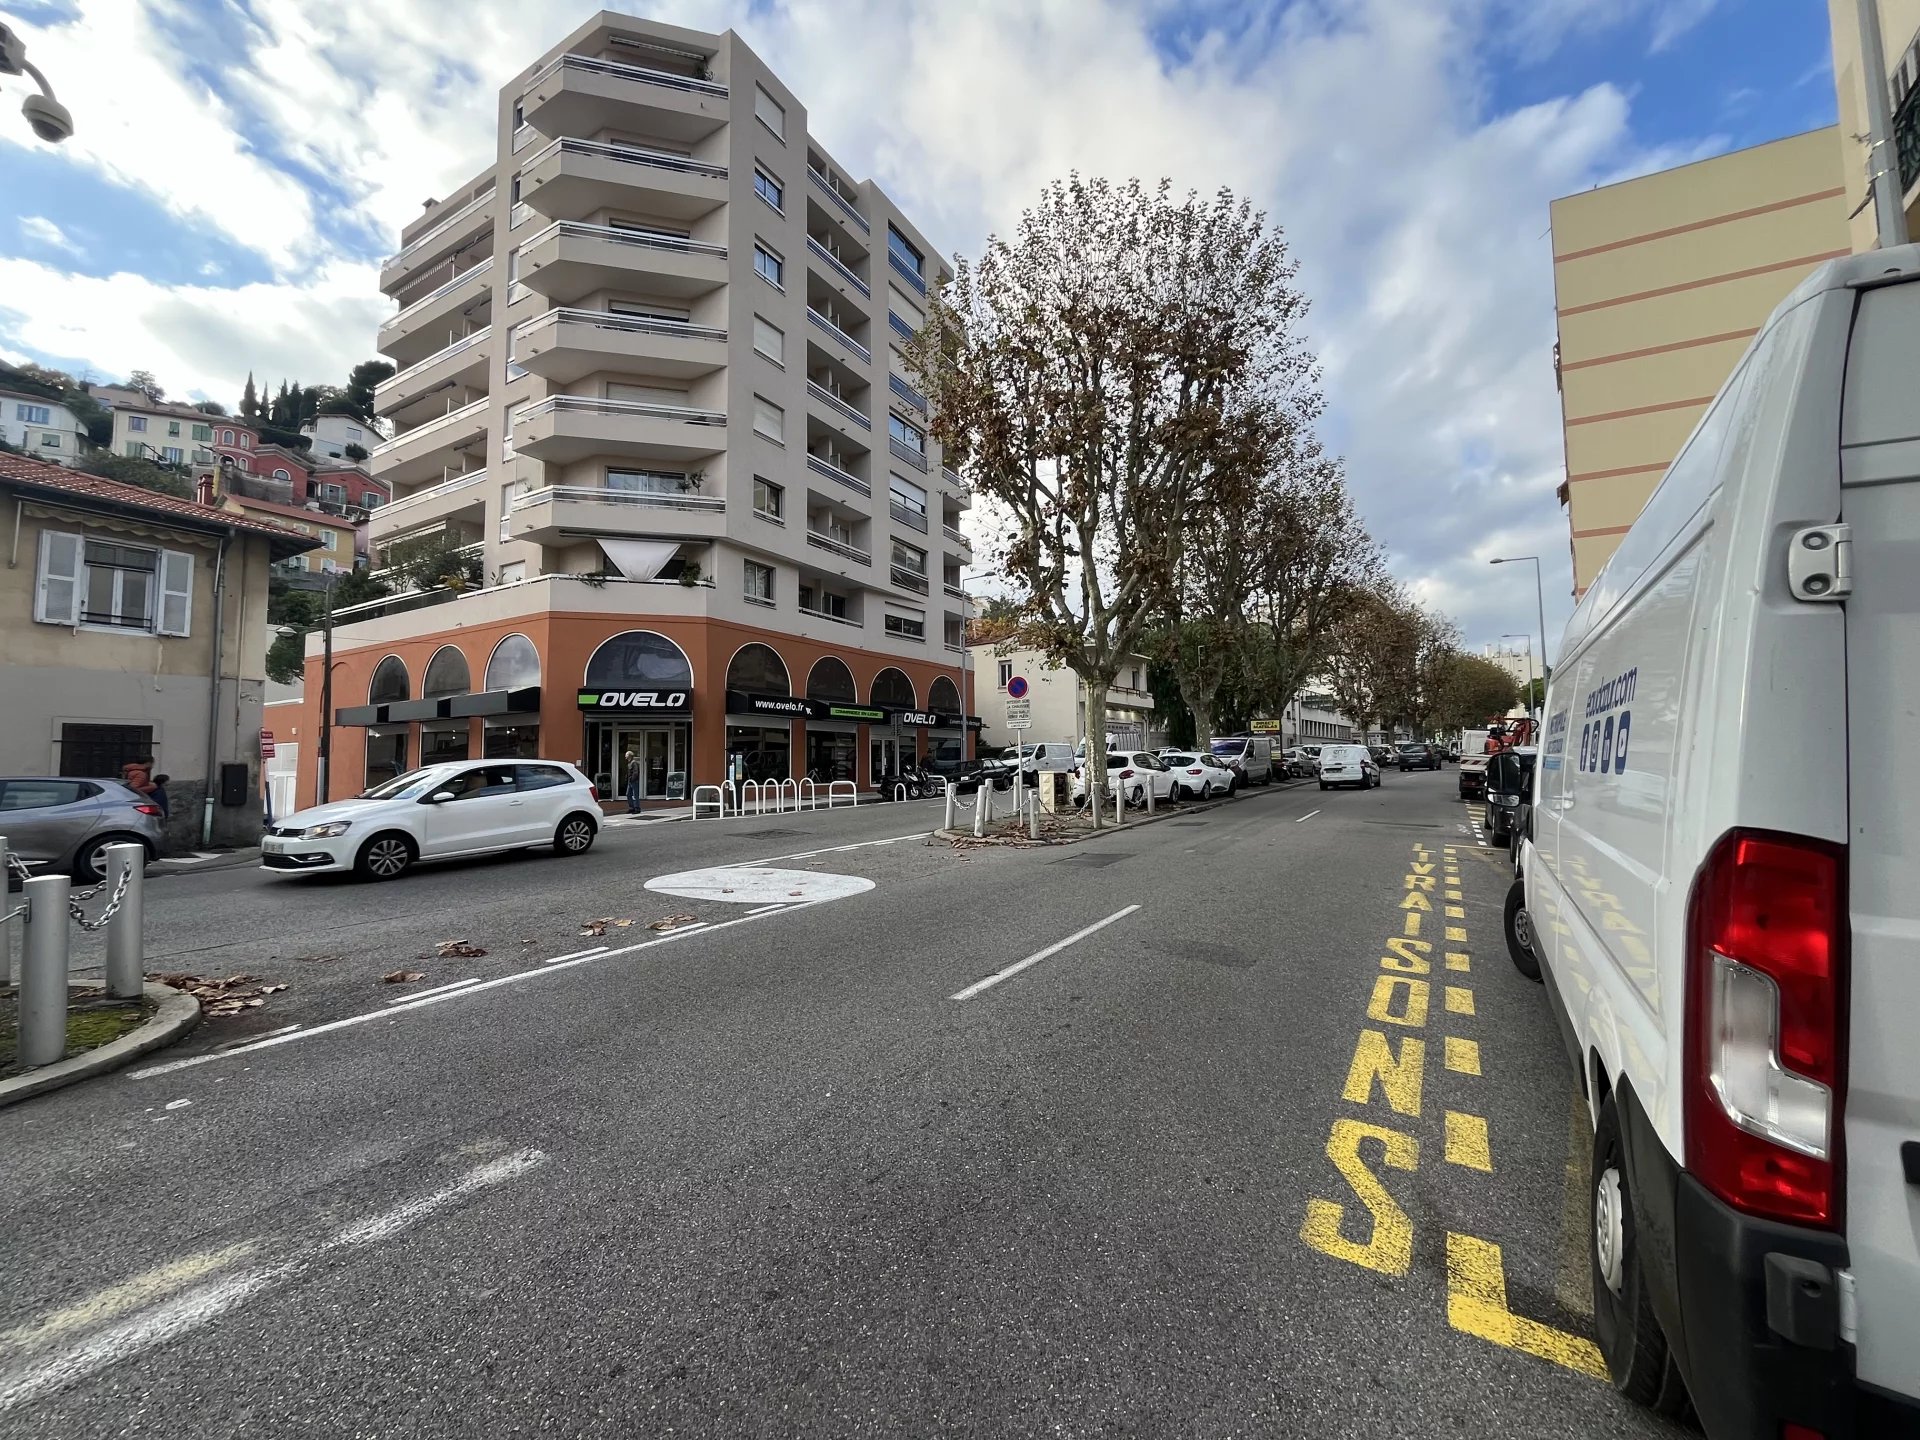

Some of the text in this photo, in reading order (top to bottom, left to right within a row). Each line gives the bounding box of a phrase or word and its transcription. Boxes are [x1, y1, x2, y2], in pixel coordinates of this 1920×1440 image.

[599, 692, 686, 707] OVELO
[755, 700, 805, 713] www.ovelo.fr
[903, 712, 936, 725] OVELO
[1300, 842, 1435, 1276] LIVRAISONS
